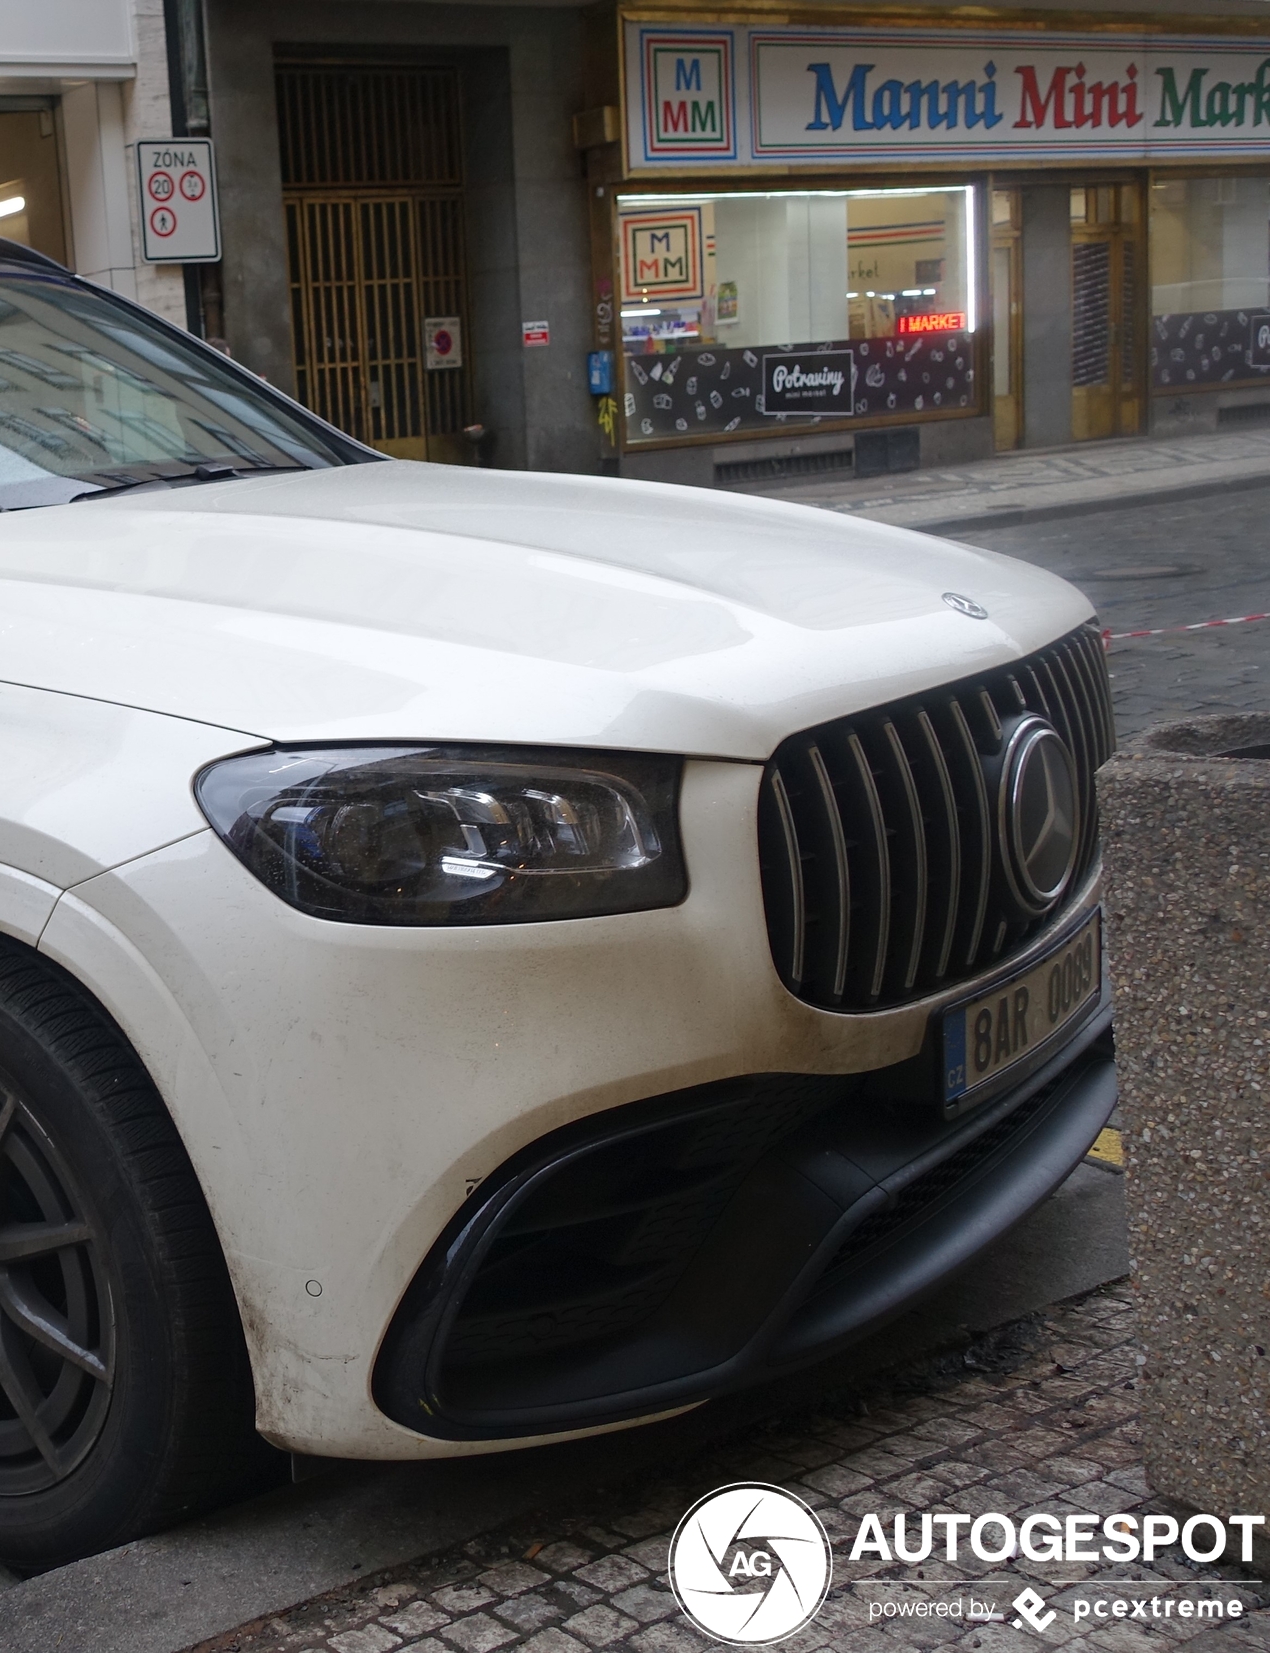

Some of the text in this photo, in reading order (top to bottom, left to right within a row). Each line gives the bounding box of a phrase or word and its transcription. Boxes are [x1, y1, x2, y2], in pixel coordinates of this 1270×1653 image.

[675, 58, 701, 91] M
[805, 60, 1003, 131] Manni
[1012, 61, 1144, 130] Mini
[152, 148, 197, 168] ZÓNA
[153, 179, 170, 195] 20
[651, 231, 670, 253] M
[773, 364, 844, 396] Potraviny
[974, 985, 1030, 1073] 8AR
[947, 1064, 964, 1089] CZ
